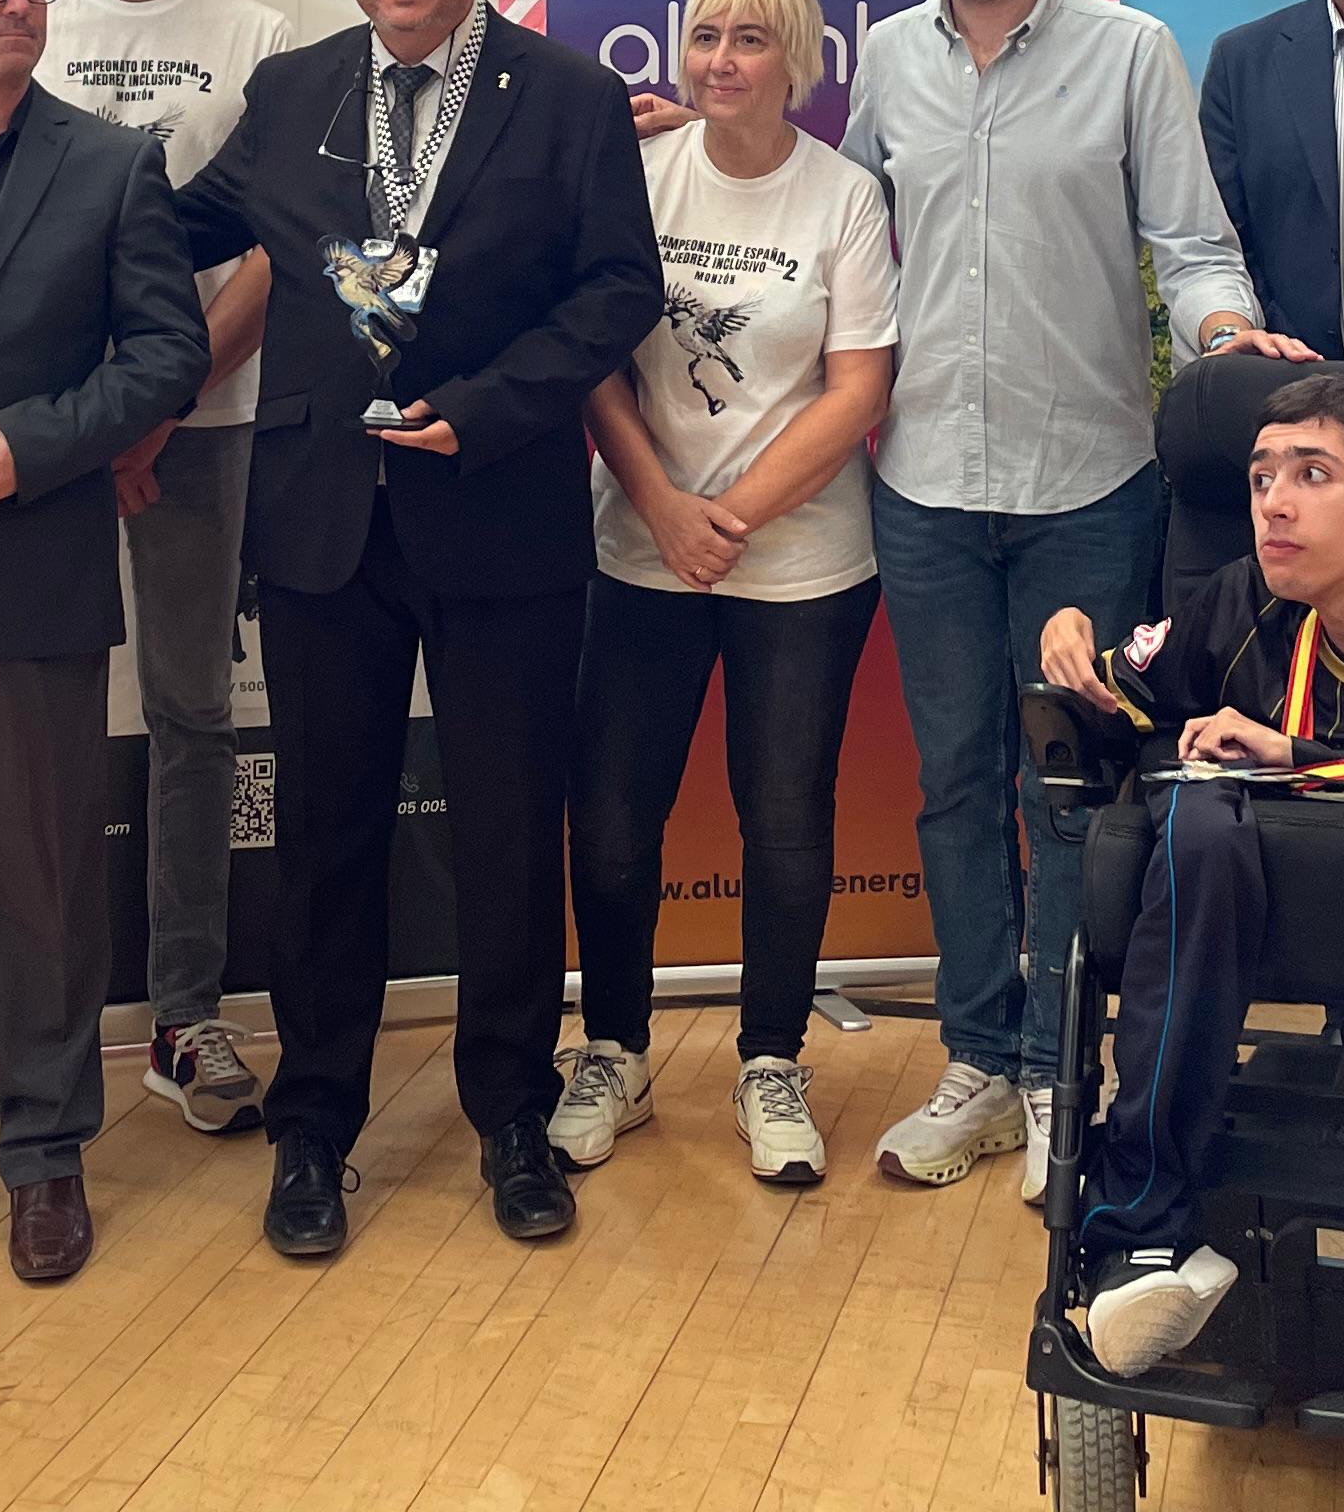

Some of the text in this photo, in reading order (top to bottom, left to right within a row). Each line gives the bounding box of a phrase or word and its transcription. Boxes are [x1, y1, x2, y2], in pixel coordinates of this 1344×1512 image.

[67, 59, 212, 93] CAMPEONATO DE ESPAÑA 2
[82, 73, 182, 87] AJEDREZ INCLUSIVO
[115, 88, 154, 102] MONZÓN
[658, 234, 799, 282] AMPEONATO DE ESPAÑA 2
[662, 250, 767, 273] AJEDREZ INCLUSIVO
[694, 270, 736, 285] MONZÓN
